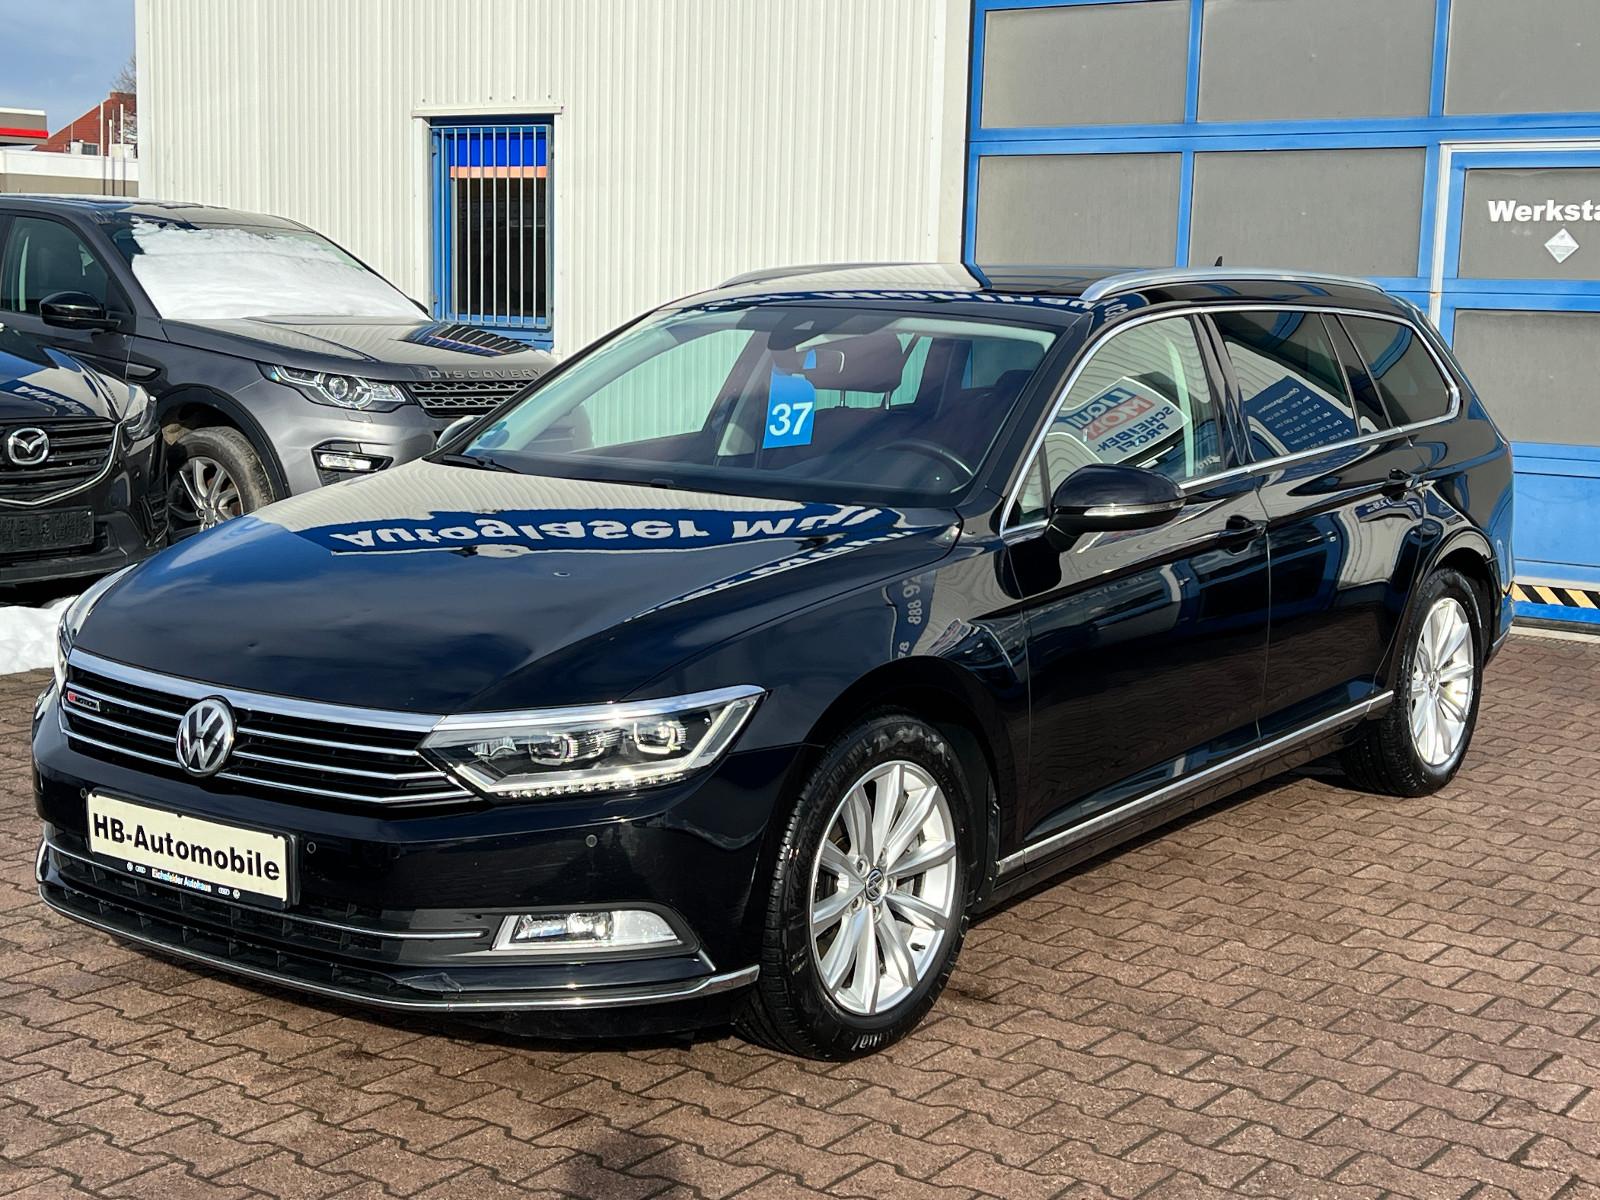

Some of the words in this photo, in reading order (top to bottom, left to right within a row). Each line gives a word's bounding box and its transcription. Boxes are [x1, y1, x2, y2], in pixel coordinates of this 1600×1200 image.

[428, 369, 541, 379] DISCOVERY
[769, 401, 813, 436] 37
[93, 813, 280, 881] HB-Automobile
